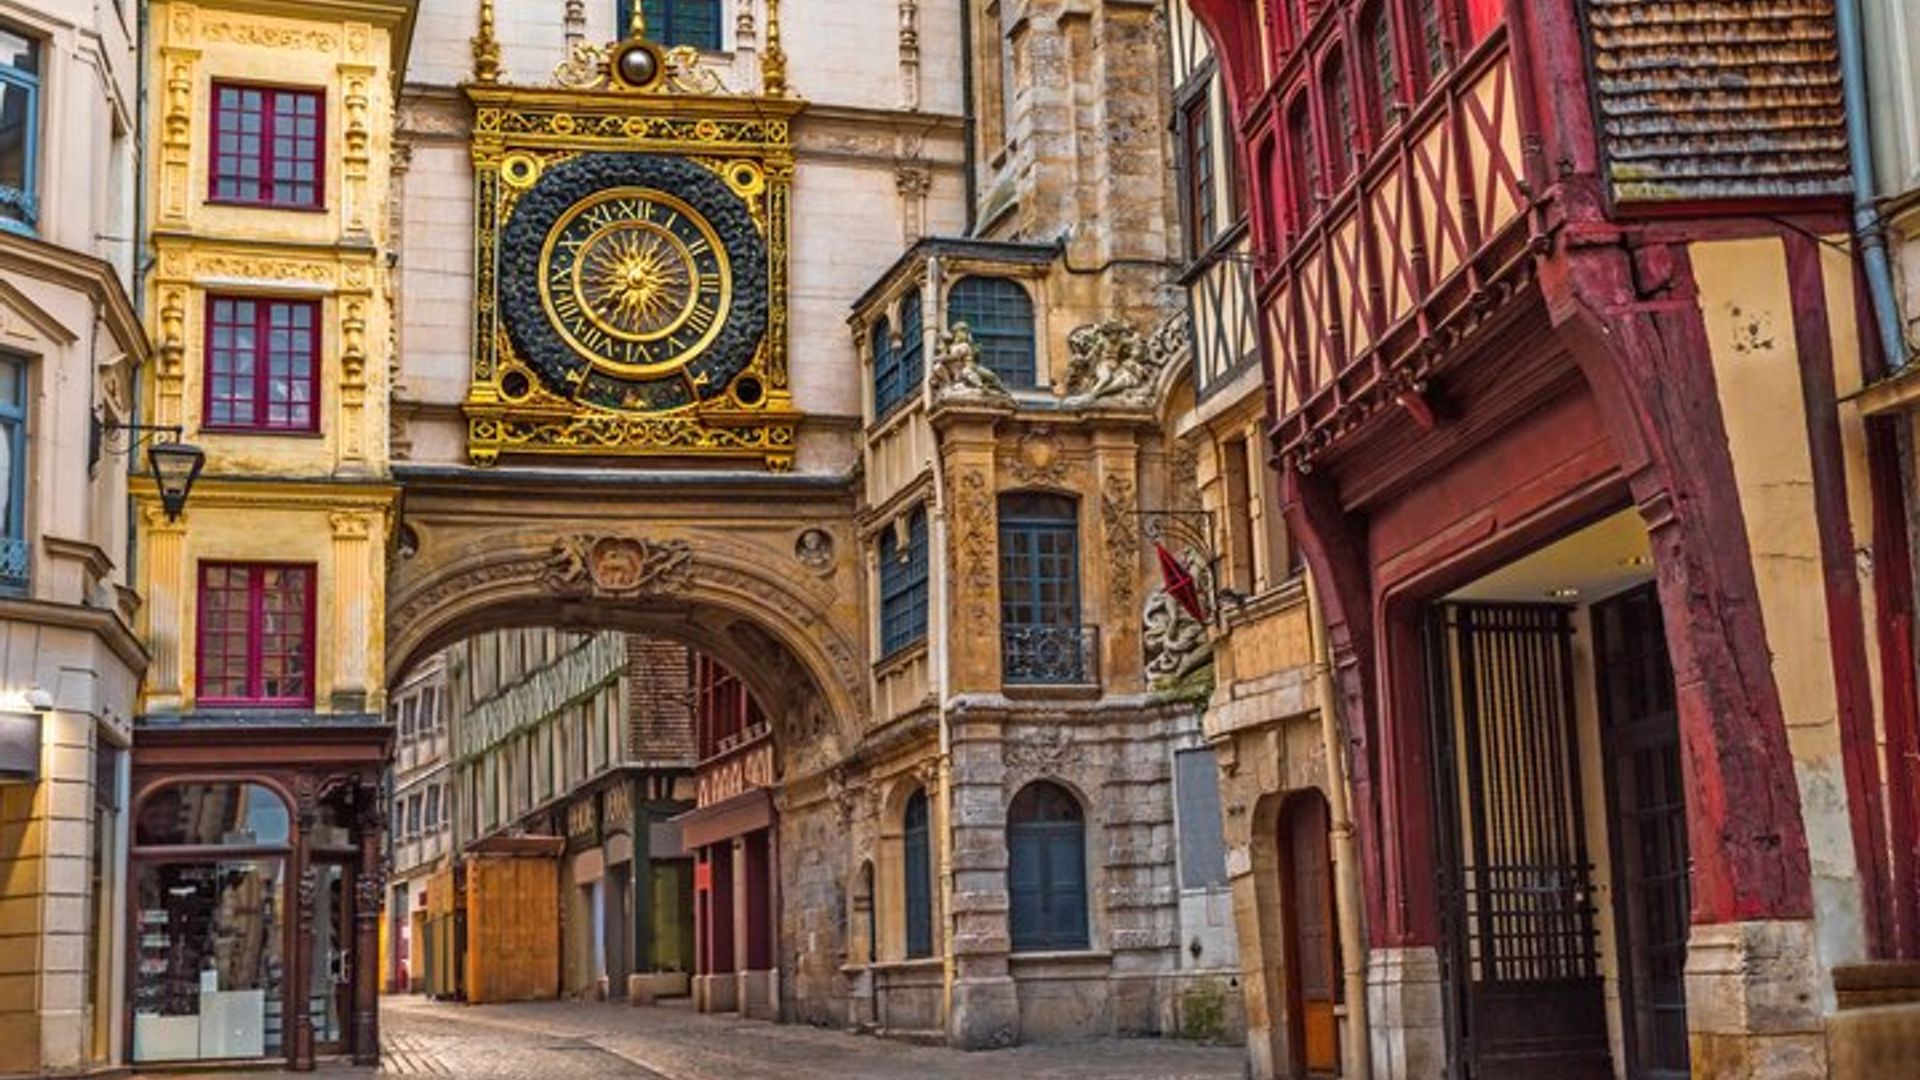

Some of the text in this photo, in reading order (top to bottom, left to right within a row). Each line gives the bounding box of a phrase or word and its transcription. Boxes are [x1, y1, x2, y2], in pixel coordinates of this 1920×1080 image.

[581, 204, 612, 232] XI
[617, 199, 652, 220] XII
[664, 211, 678, 229] I
[558, 230, 583, 256] X
[688, 238, 710, 256] II
[551, 265, 572, 290] IX
[700, 273, 718, 292] III
[687, 304, 715, 334] IIII
[583, 327, 612, 358] VII
[626, 342, 652, 362] VI
[668, 336, 686, 357] V
